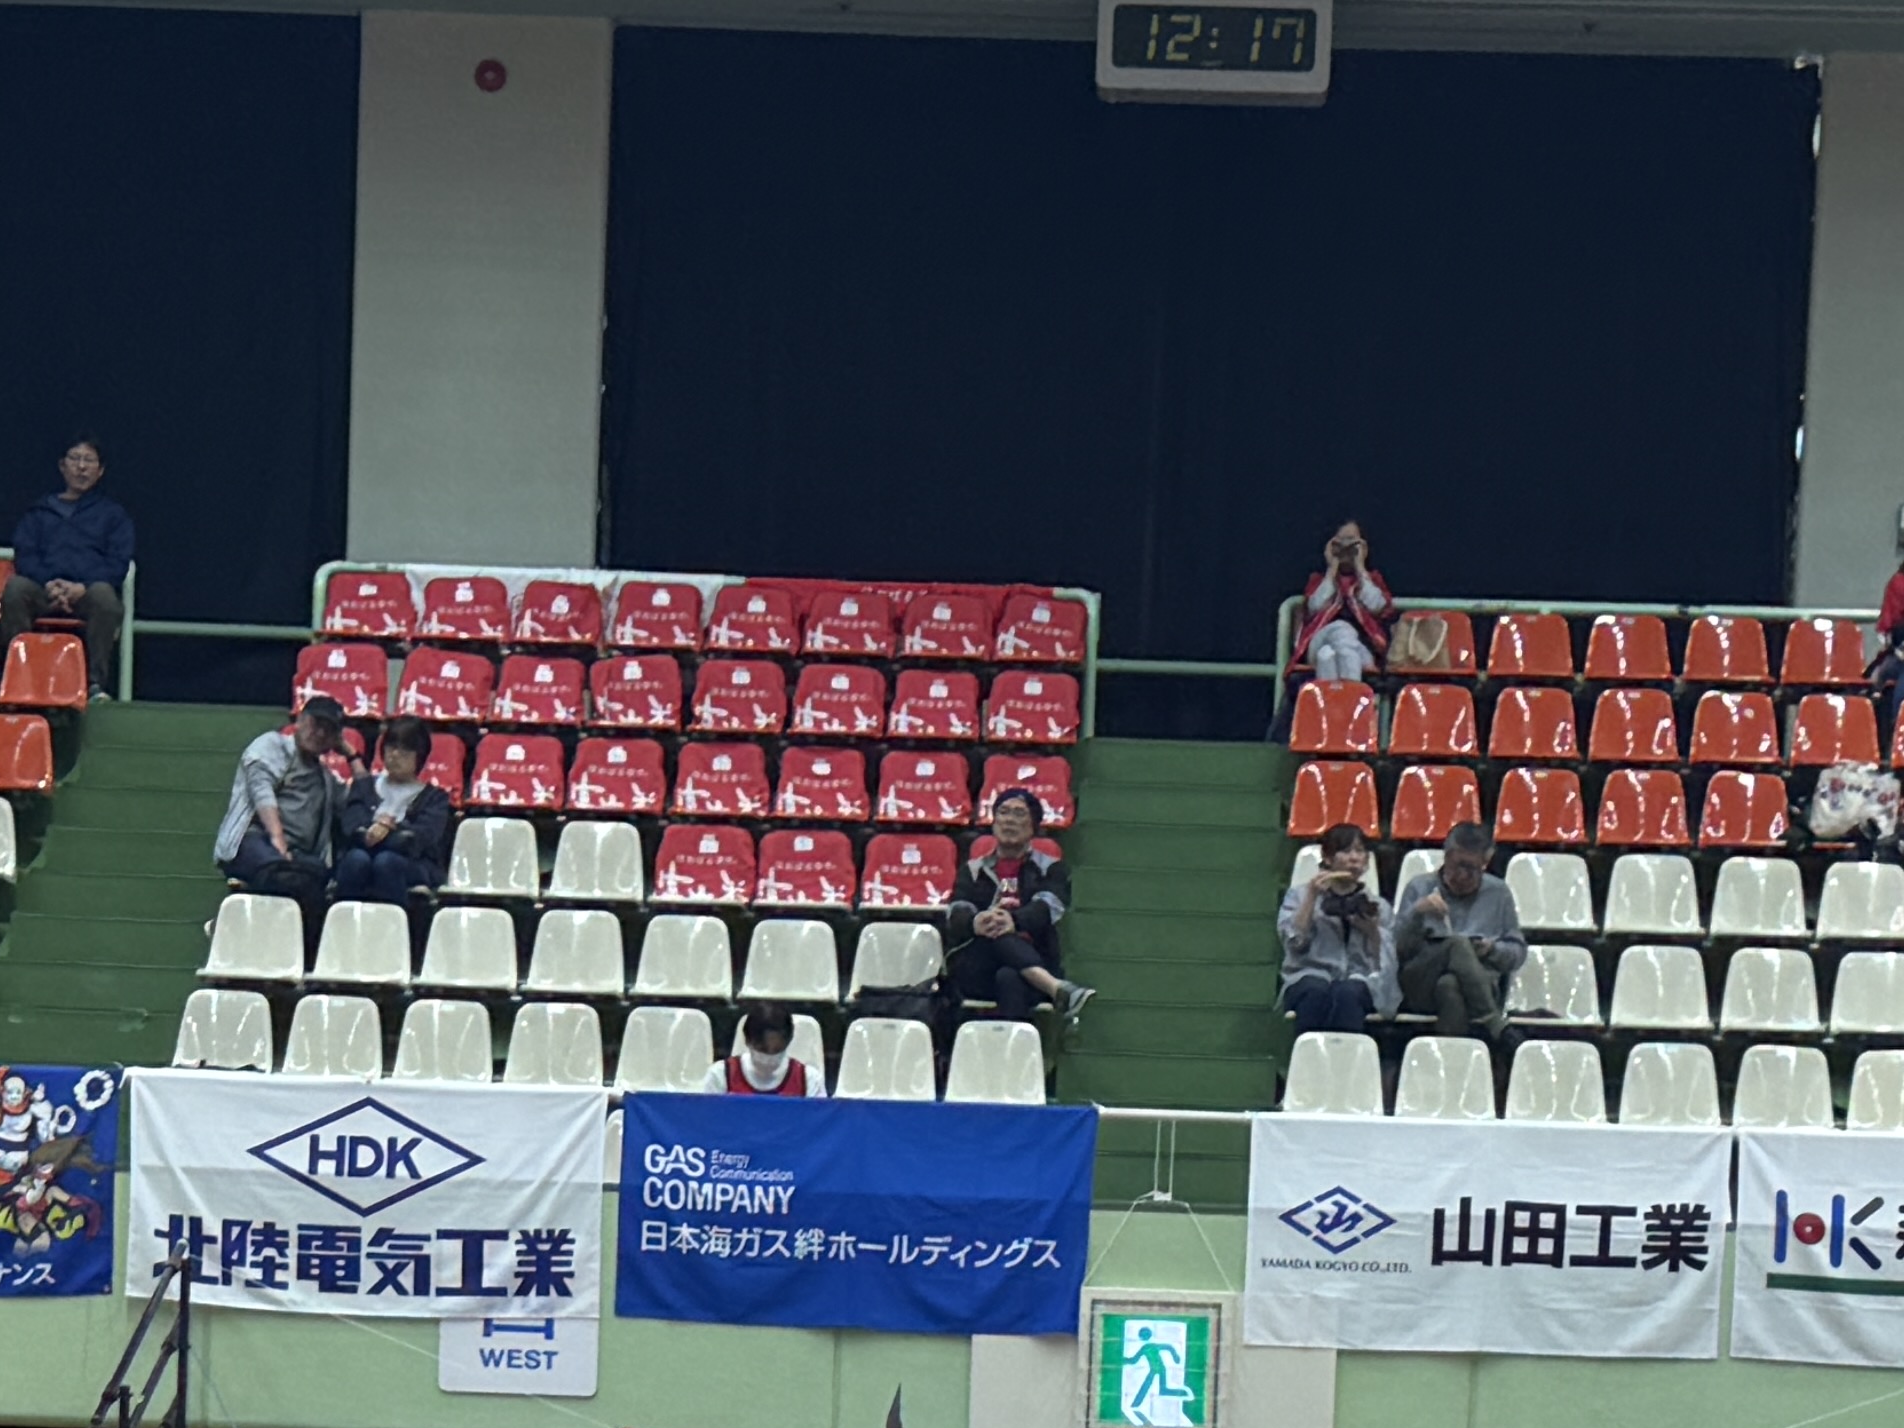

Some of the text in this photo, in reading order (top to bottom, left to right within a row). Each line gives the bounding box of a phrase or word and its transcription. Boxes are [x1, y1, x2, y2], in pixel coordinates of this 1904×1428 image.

[1146, 13, 1305, 64] 12:17
[308, 1134, 424, 1180] HDK
[644, 1143, 706, 1177] GAS
[709, 1164, 795, 1182] Communication
[710, 1149, 751, 1168] Energy
[642, 1177, 795, 1216] COMPANY
[640, 1220, 1062, 1270] 日本海ガス絆ホールディングス
[1431, 1196, 1712, 1273] 山田工業
[152, 1214, 576, 1298] 北陸電気工業
[1261, 1257, 1312, 1270] YAMADA
[1315, 1260, 1359, 1272] KOGYO
[479, 1348, 558, 1371] WEST
